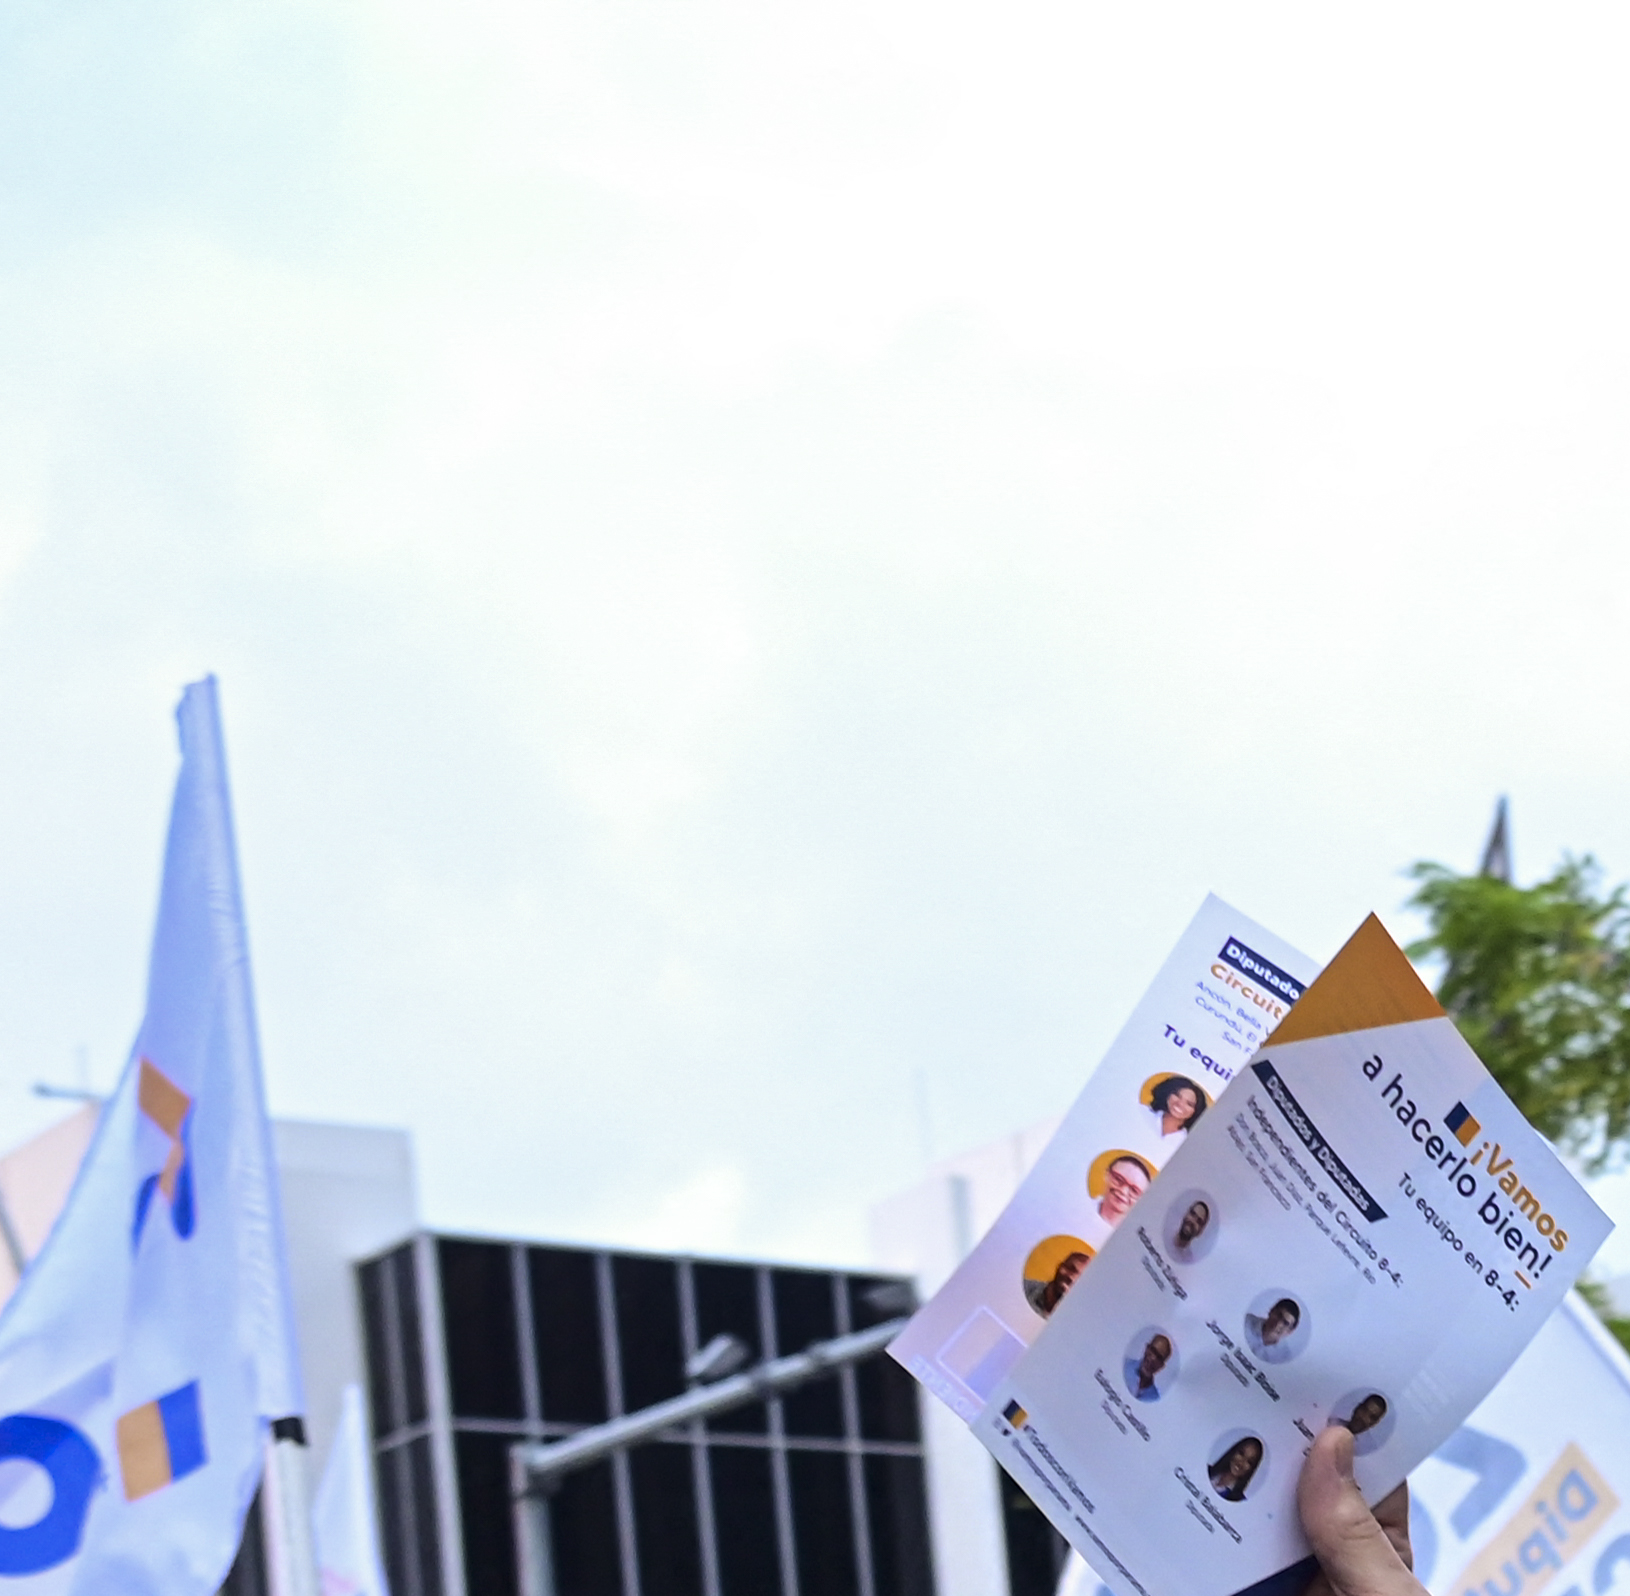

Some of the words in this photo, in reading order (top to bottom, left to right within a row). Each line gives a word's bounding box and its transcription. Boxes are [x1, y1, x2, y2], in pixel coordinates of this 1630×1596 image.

[1164, 1024, 1186, 1049] Tu
[1190, 1046, 1235, 1082] equi
[1210, 963, 1284, 1020] Circuit
[1247, 1094, 1318, 1193] Independientes
[1316, 1190, 1338, 1214] del
[1335, 1210, 1379, 1261] Circuito
[1266, 1075, 1313, 1142] Diputados
[1318, 1146, 1371, 1212] Diputadas
[1362, 1054, 1383, 1082] a
[1381, 1073, 1477, 1198] hacerlo
[1478, 1191, 1553, 1280] bien!
[1470, 1141, 1570, 1253] ¡Vamos
[1398, 1171, 1417, 1198] Tu
[1416, 1197, 1464, 1252] equipo
[1465, 1249, 1485, 1275] en
[1484, 1269, 1520, 1312] 8-4:
